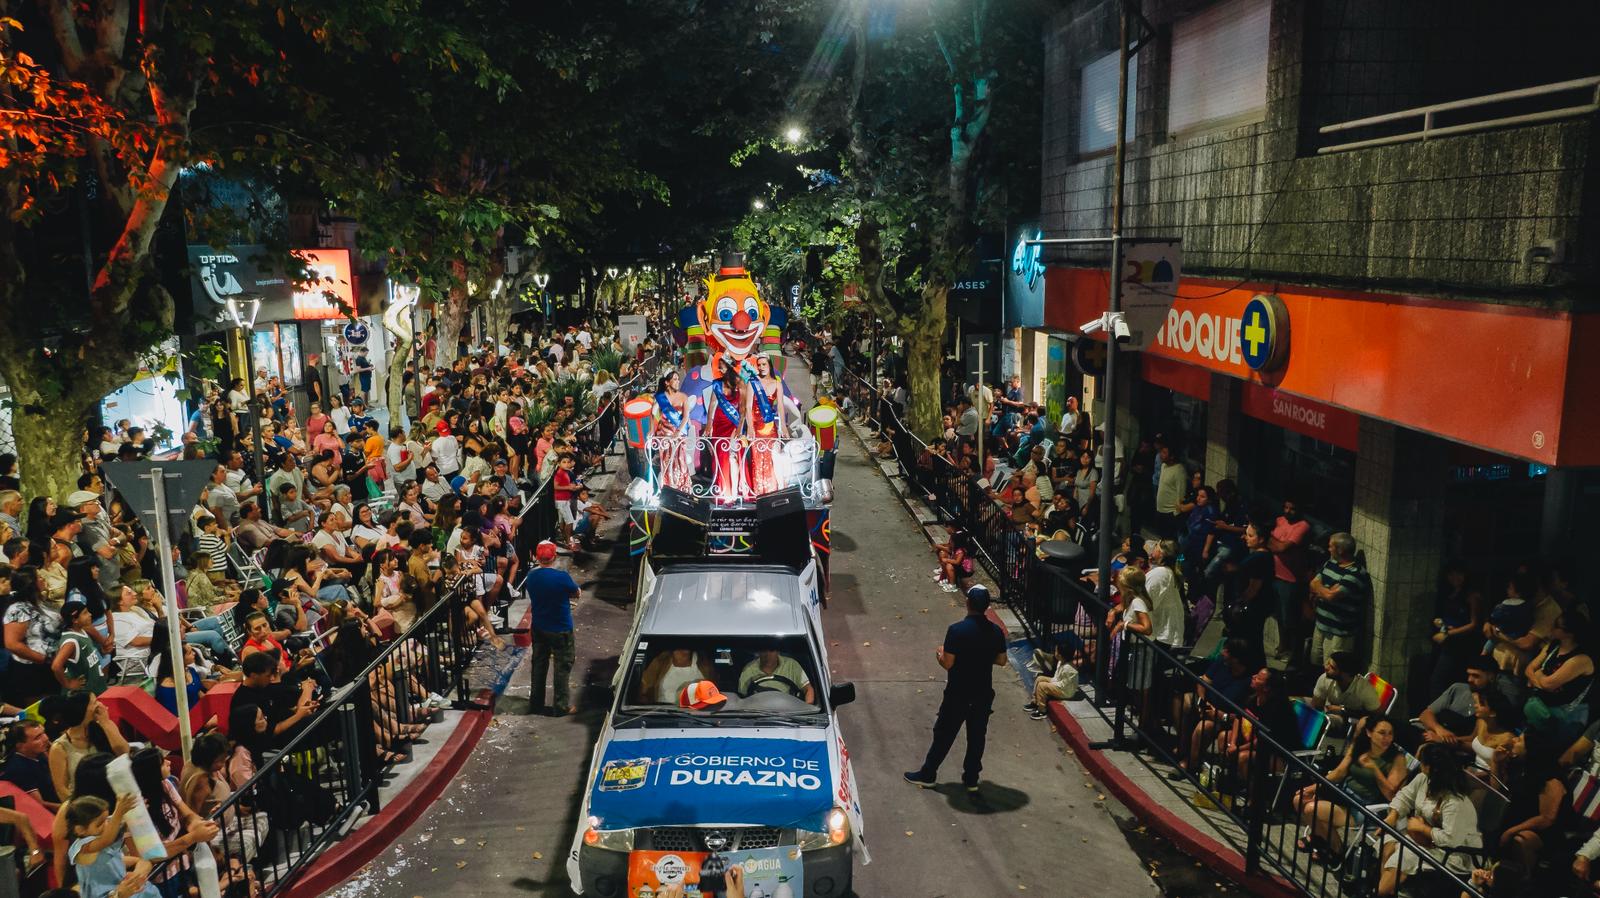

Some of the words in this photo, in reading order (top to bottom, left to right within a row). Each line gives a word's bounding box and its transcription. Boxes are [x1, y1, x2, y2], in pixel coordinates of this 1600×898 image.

[1167, 308, 1242, 365] ROQUE
[675, 755, 786, 767] GOBIERNO
[793, 758, 820, 771] DE
[670, 770, 821, 790] DURAZNO
